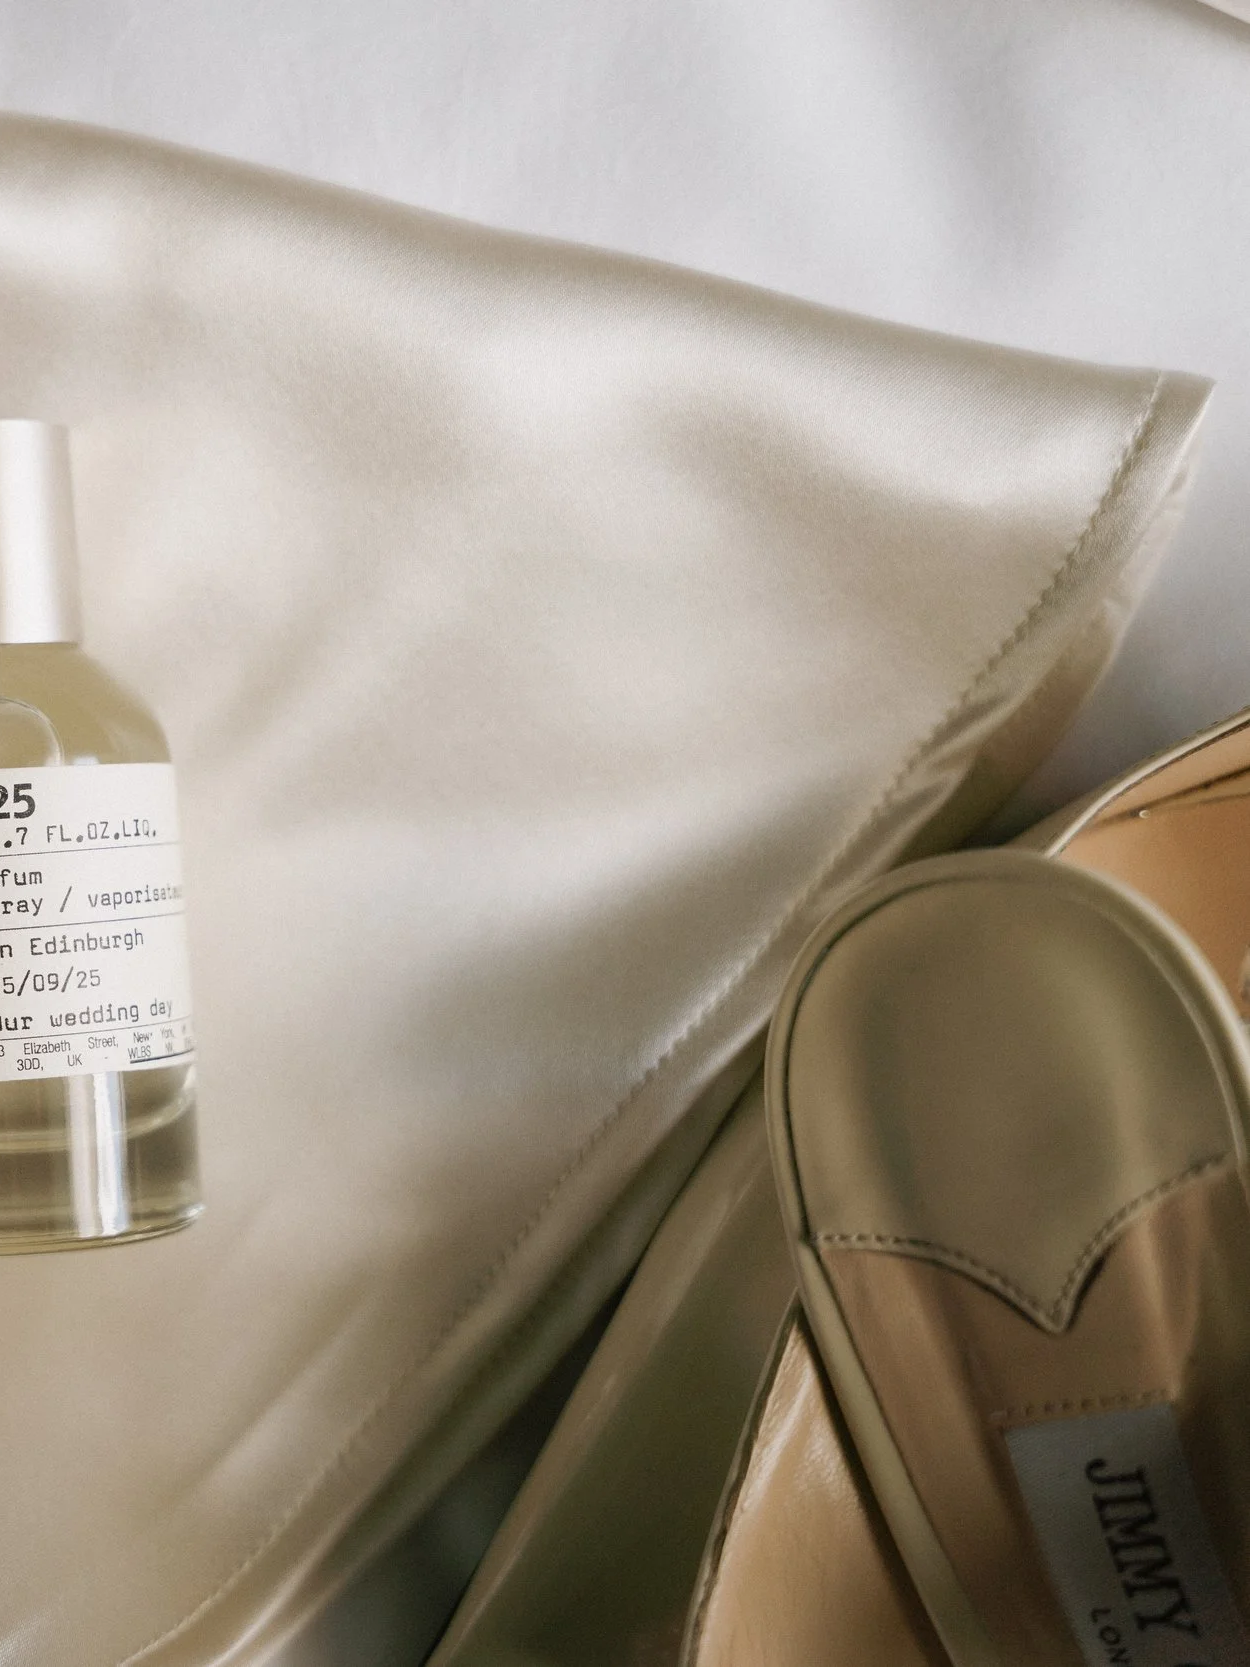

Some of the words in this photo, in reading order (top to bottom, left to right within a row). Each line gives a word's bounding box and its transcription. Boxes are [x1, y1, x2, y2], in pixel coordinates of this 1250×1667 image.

[59, 885, 72, 913] /
[28, 929, 145, 955] Edinburgh
[50, 1003, 141, 1028] wedding
[149, 998, 173, 1018] day
[16, 1057, 44, 1072] 3DD,
[67, 1054, 83, 1067] UK
[127, 1045, 152, 1060] WLBS
[23, 1040, 71, 1055] Elizabeth
[87, 1036, 119, 1050] Street,
[1084, 1458, 1201, 1639] JIMMY
